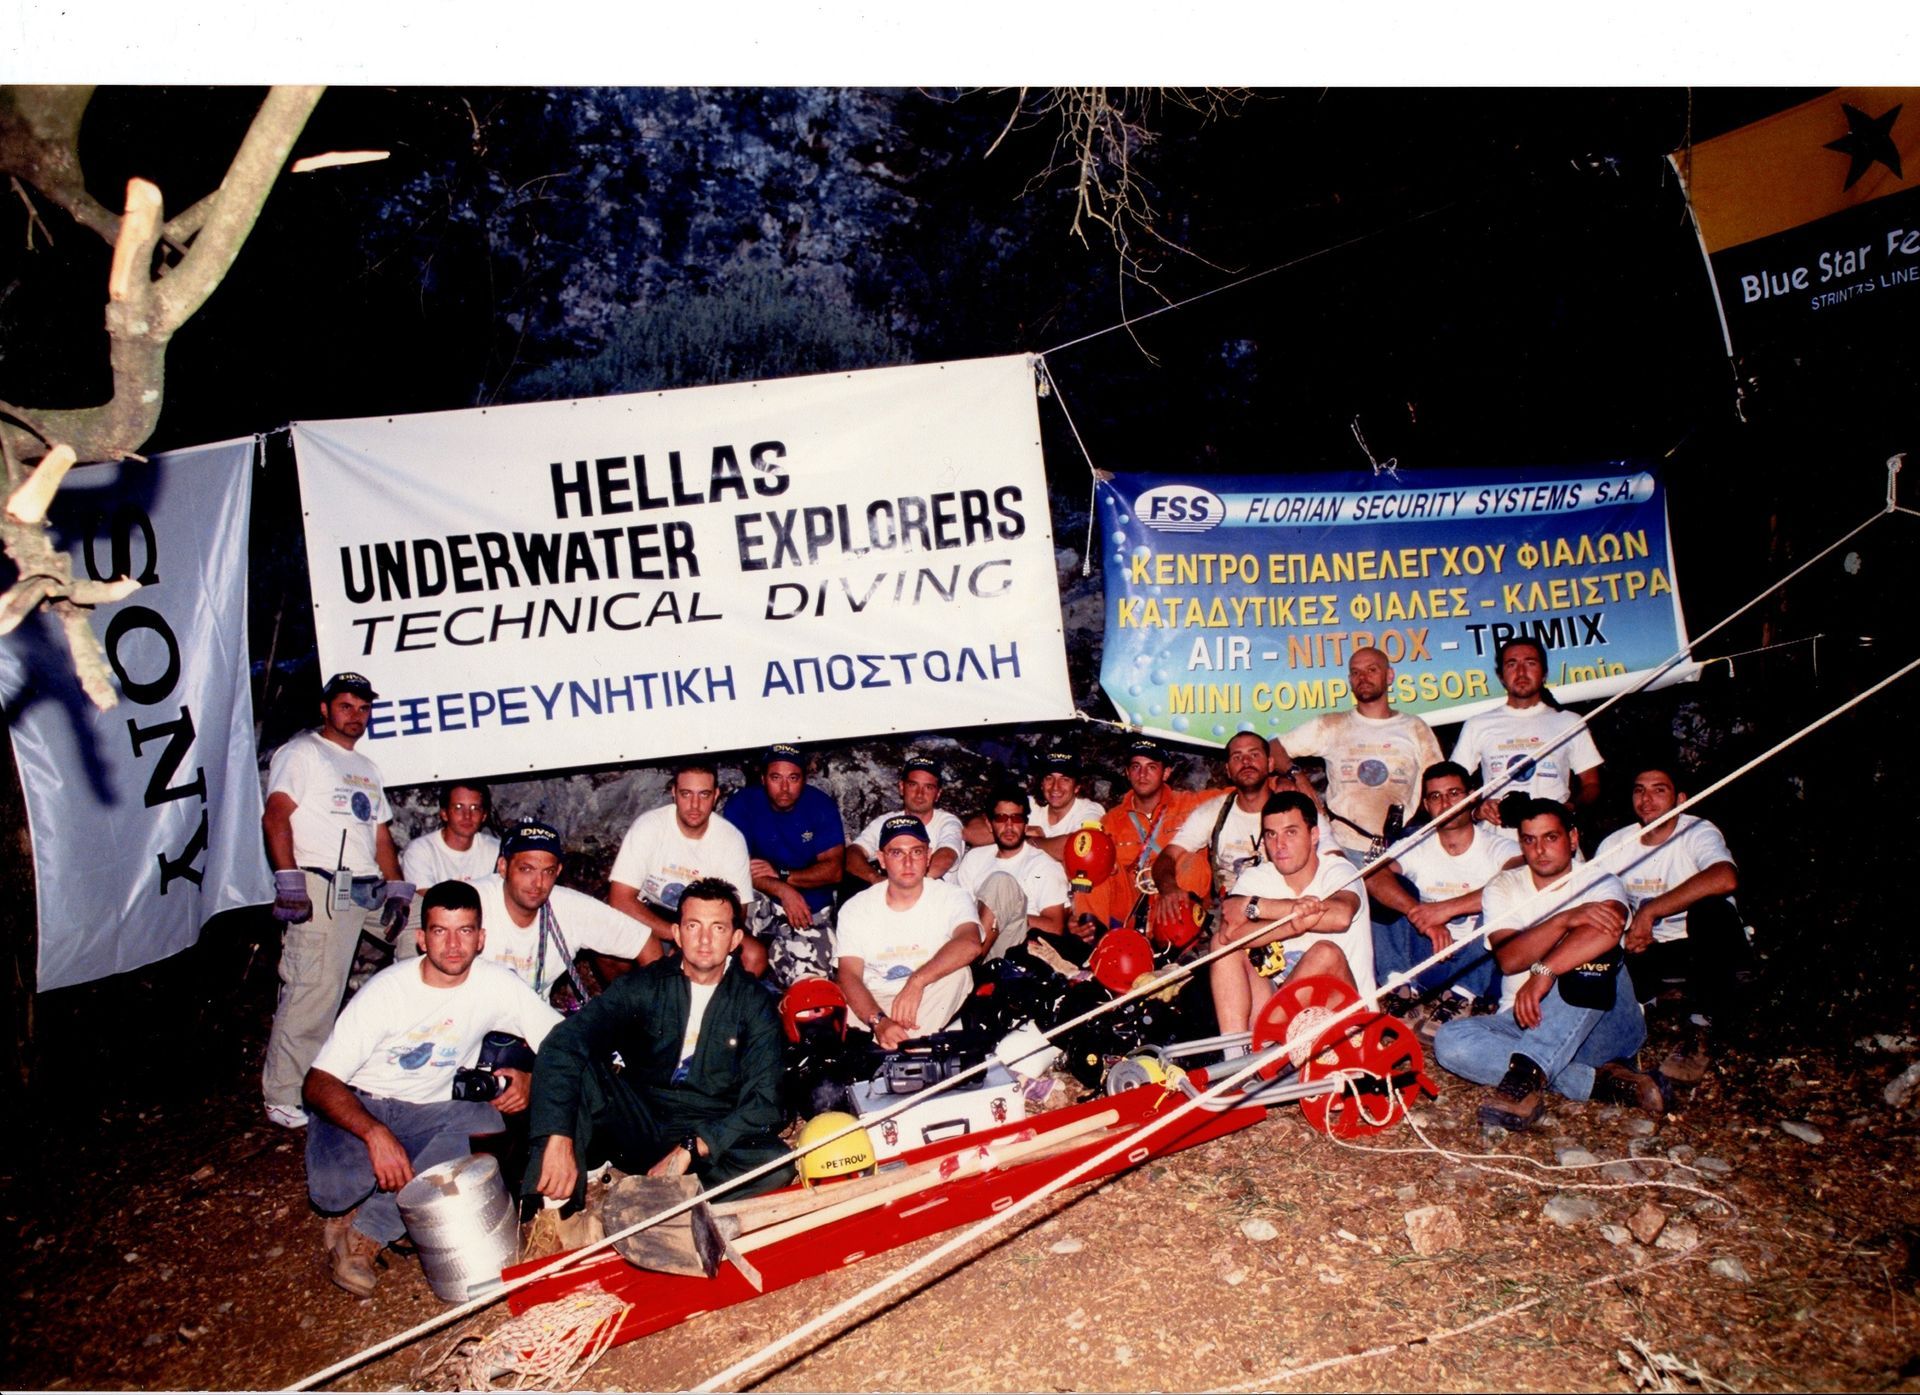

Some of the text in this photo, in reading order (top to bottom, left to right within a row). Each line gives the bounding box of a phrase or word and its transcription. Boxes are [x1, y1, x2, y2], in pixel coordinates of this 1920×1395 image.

[1741, 267, 1810, 303] Blue
[1819, 245, 1872, 283] Star
[550, 440, 790, 519] HELLAS
[1149, 495, 1210, 523] FSS
[1245, 478, 1635, 523] FLORIAN SECURITY SYSTEMS S.A.
[340, 485, 1026, 604] UNDERWATER EXPLORERS
[1131, 529, 1649, 586] ΚΕΝΤΡΟ ΕΠΑΝΕΛΕΓΧΟΥ ΦΙΑΛΩΝ
[351, 558, 1014, 656] TECHNICAL DIVING
[1118, 595, 1341, 629] ΚΑΤΑΔΥΤΙΚΕΣ
[1350, 587, 1471, 623] ΦΙΑΛΕΣ
[1502, 567, 1672, 613] ΚΛΕΙΣΤΡΑ
[1188, 635, 1252, 671] AIR
[83, 504, 209, 897] SONY
[366, 641, 1021, 740] ΕΞΕΡΕΥΝΗΤΙΚΗ ΑΠΟΣΤΟΛΗ
[1168, 682, 1242, 714] MINI
[1252, 669, 1490, 713] COMPSSOR
